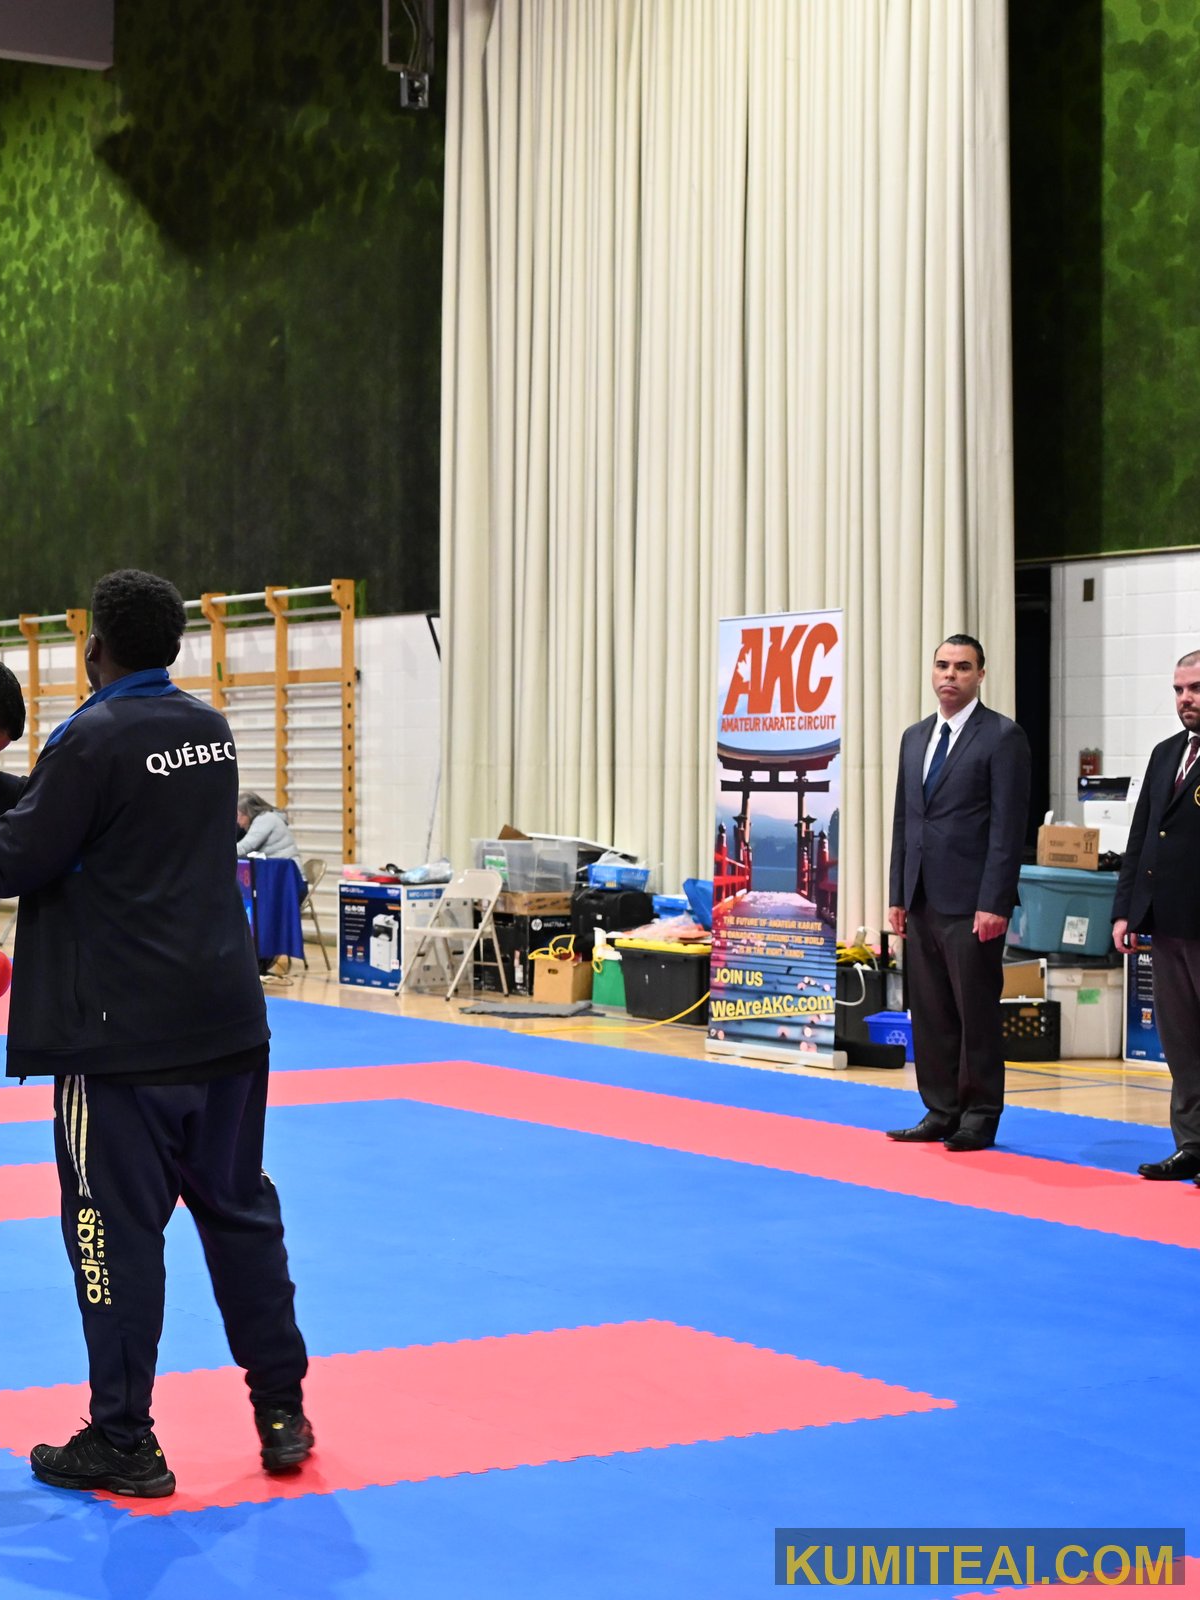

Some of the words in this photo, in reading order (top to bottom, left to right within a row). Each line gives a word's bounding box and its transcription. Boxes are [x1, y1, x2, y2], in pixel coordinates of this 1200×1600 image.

[722, 622, 838, 715] AKC
[721, 717, 761, 732] AMATEUR
[762, 716, 797, 731] KARATE
[797, 715, 836, 730] CIRCUIT
[146, 742, 235, 776] QUÉBEC
[723, 916, 735, 925] THE
[736, 917, 758, 927] FUTURE
[759, 918, 767, 927] OF
[768, 919, 797, 929] AMATEUR
[798, 921, 822, 931] KARATE
[804, 936, 824, 946] WORLD
[714, 968, 743, 985] JOIN
[745, 971, 764, 987] US
[711, 995, 834, 1018] WeAreAKC.com
[77, 1208, 102, 1304] adidas
